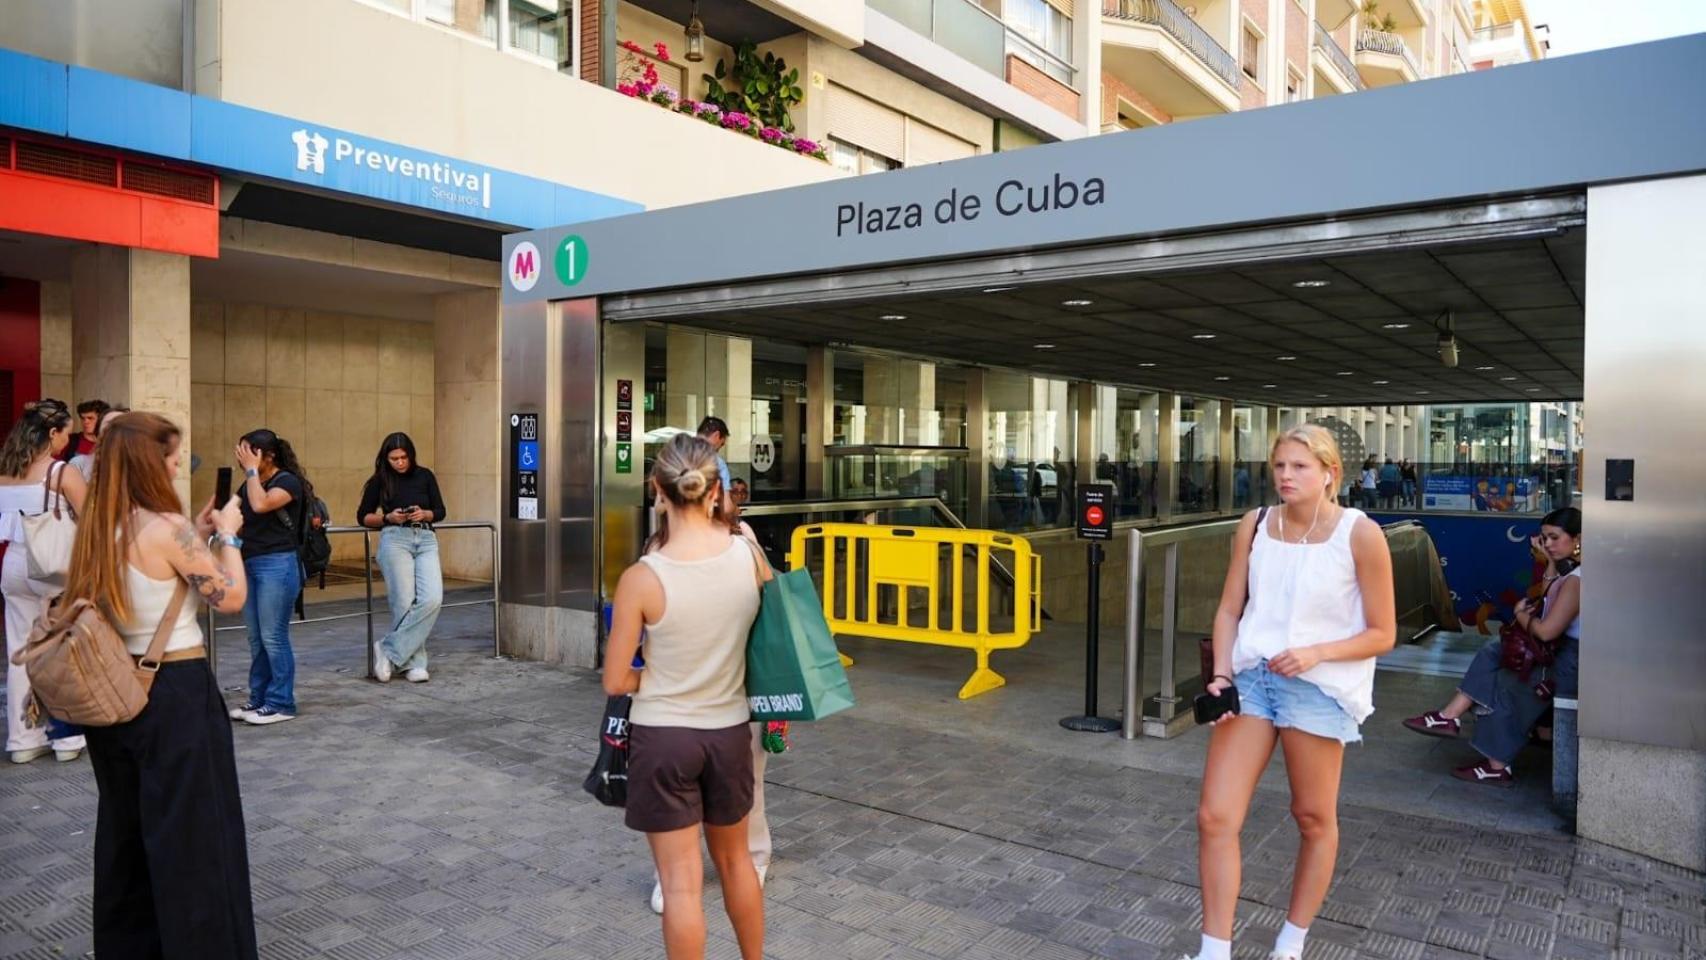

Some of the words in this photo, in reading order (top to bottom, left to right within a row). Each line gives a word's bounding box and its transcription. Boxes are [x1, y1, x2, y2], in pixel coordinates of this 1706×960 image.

[335, 138, 480, 192] Preventiva
[431, 185, 480, 207] Seguros
[836, 201, 923, 237] Plaza
[934, 188, 982, 225] de
[995, 173, 1106, 216] Cuba
[515, 250, 534, 280] M
[564, 240, 575, 280] 1
[768, 693, 803, 713] BRAND
